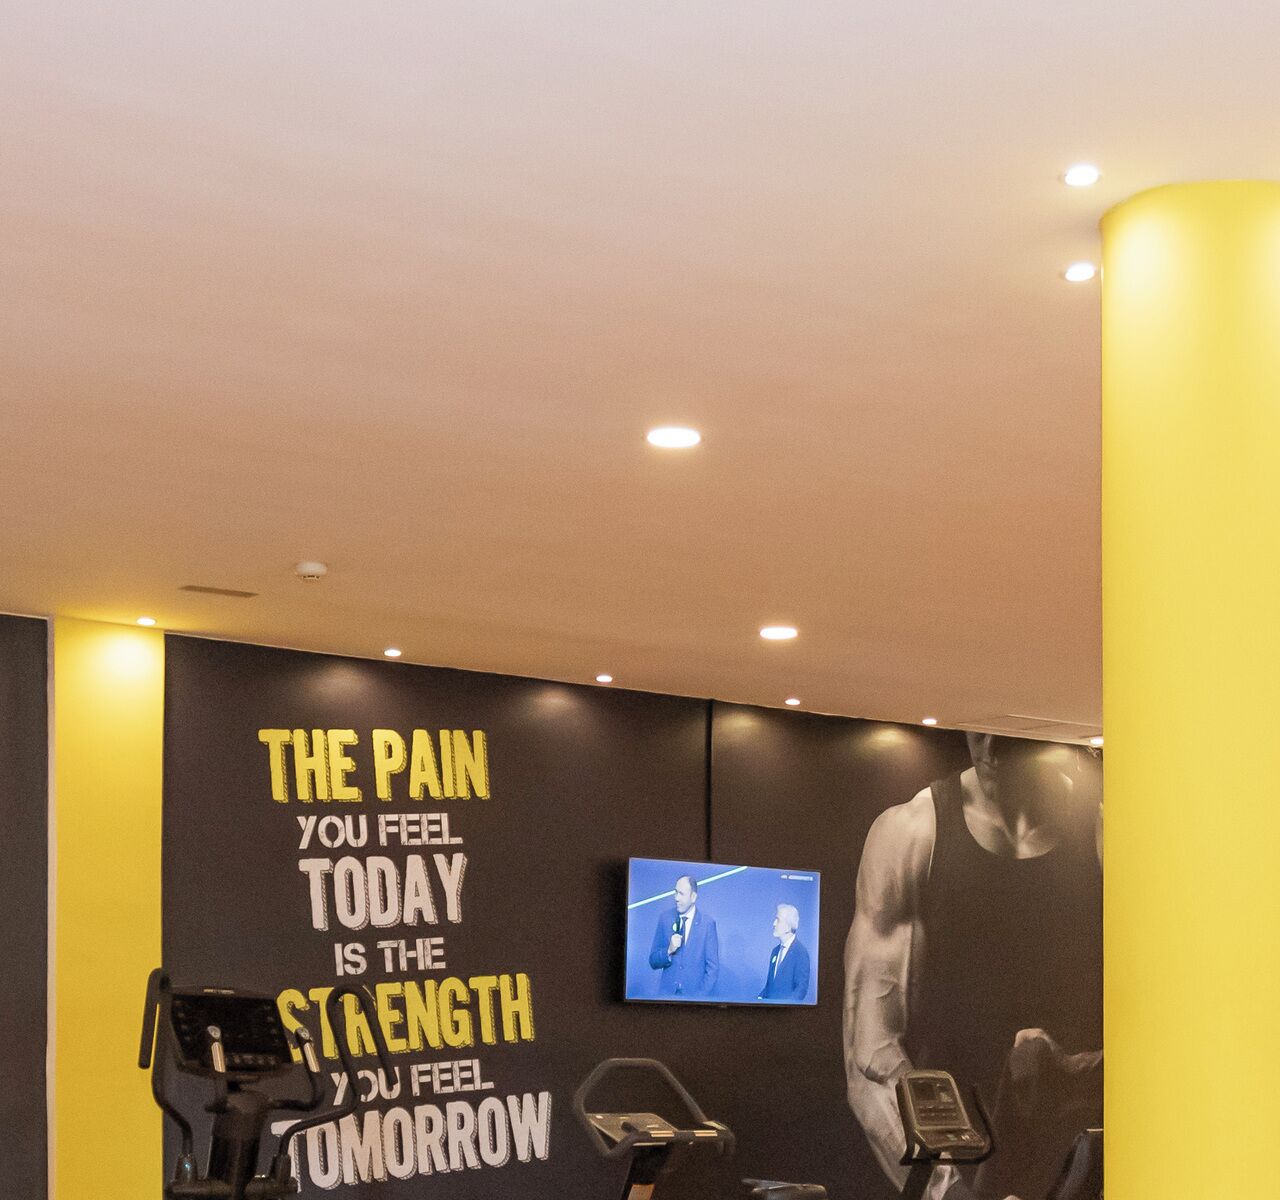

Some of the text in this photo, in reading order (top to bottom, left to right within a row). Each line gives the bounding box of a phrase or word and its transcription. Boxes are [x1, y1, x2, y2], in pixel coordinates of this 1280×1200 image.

[258, 728, 491, 803] THE PAIN
[296, 812, 463, 850] YOU FEEL
[298, 852, 468, 931] TODAY
[333, 936, 446, 976] IS THE
[330, 1058, 495, 1106] YOU FEEL
